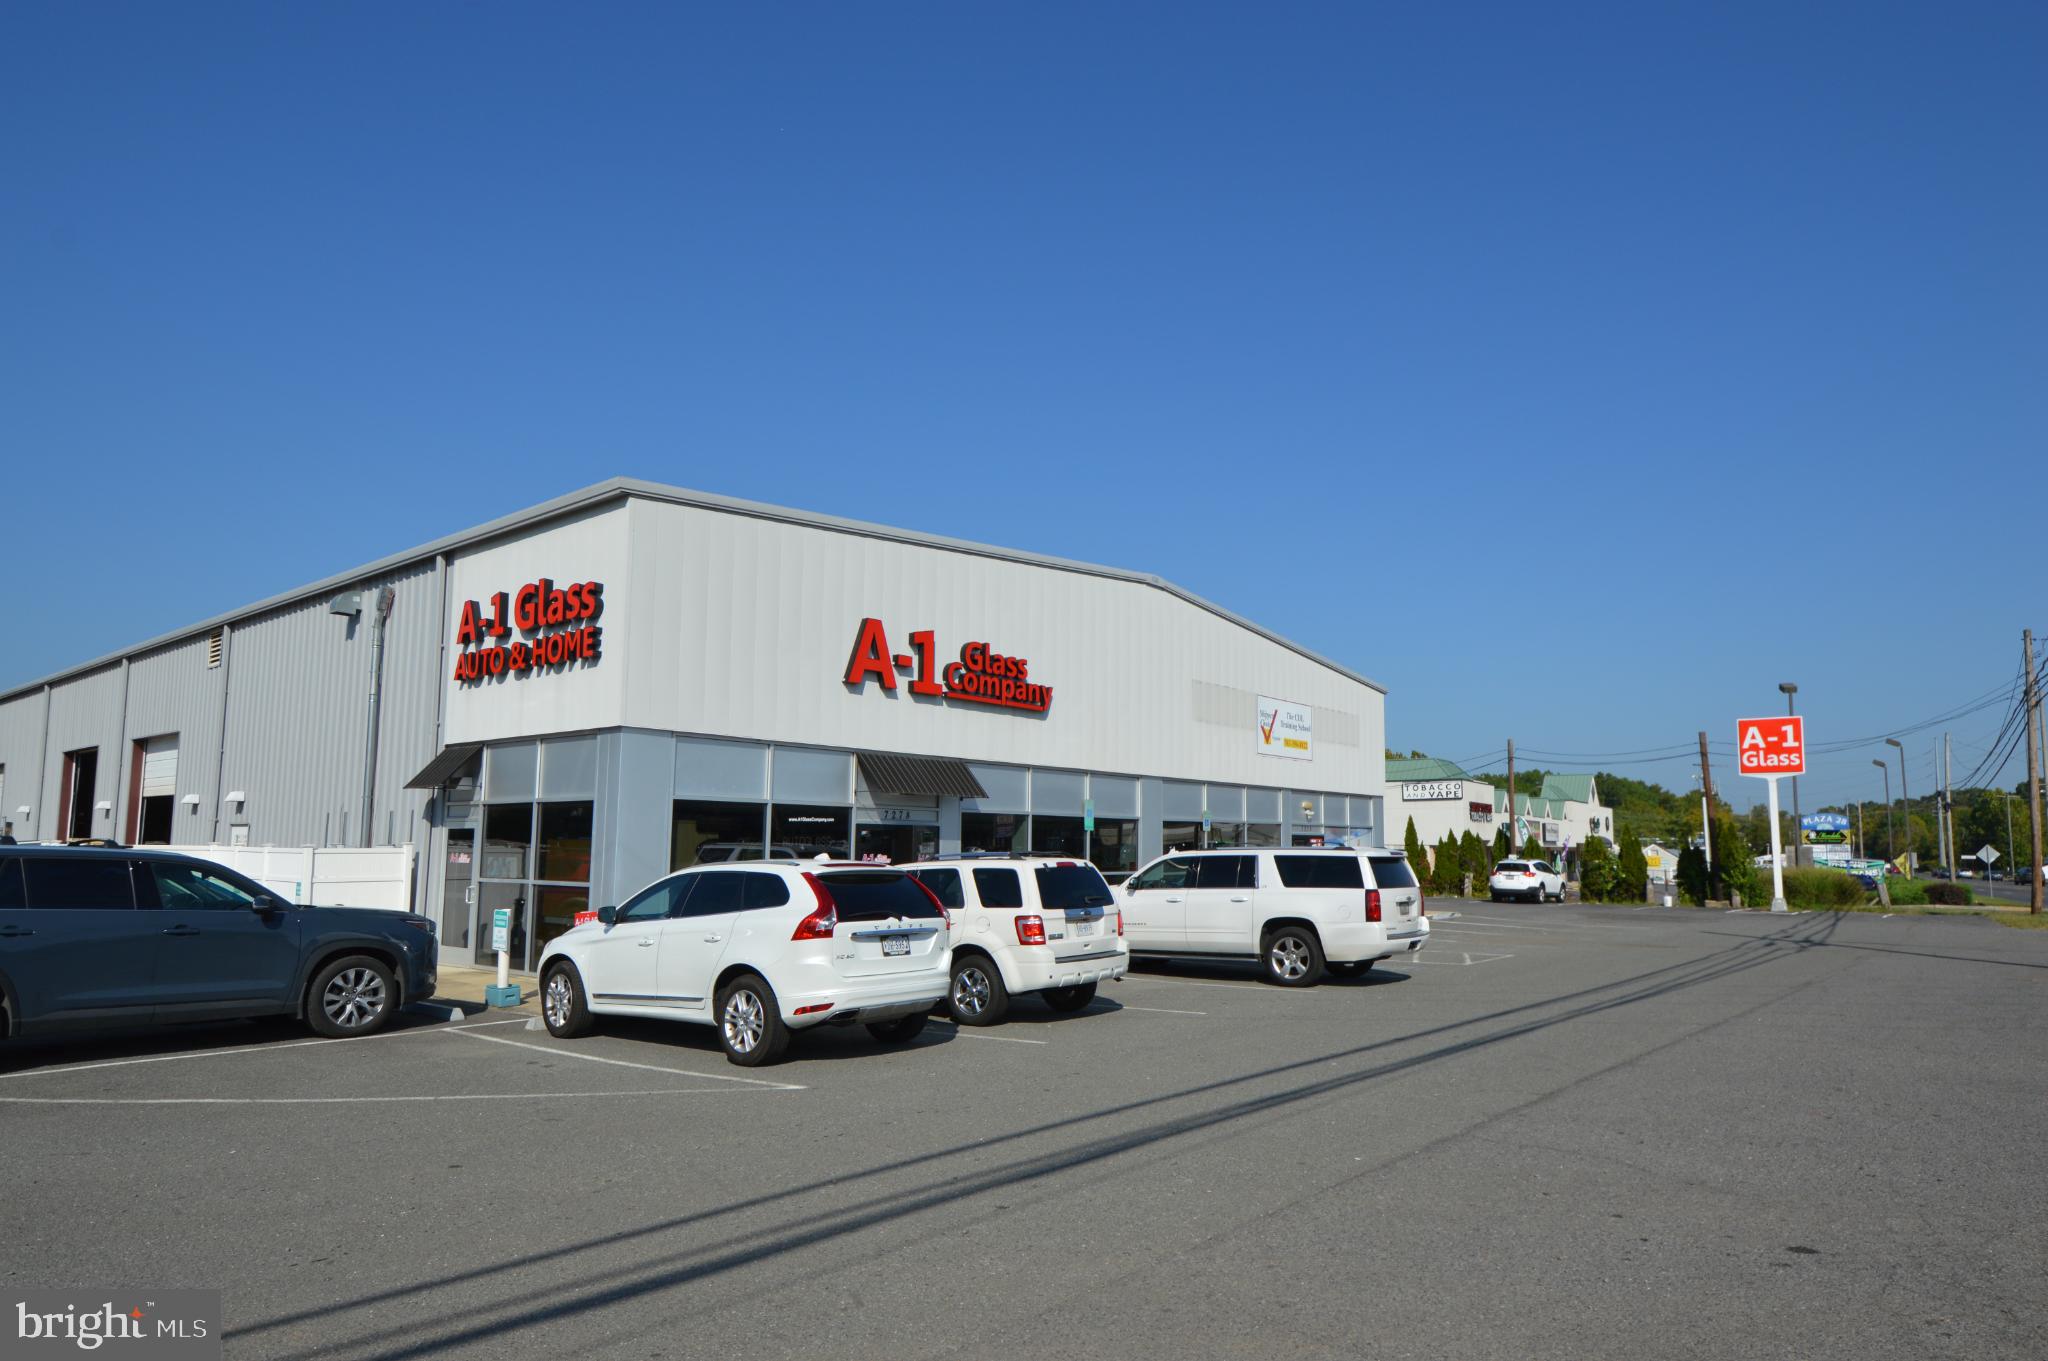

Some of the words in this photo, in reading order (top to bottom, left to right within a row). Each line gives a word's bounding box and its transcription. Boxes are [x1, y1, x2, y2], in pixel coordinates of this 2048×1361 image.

[456, 591, 509, 645] A-1
[514, 578, 601, 631] Glass
[454, 646, 506, 681] AUTO
[509, 642, 527, 671] &
[532, 626, 600, 667] HOME
[844, 618, 942, 697] A-1
[961, 641, 1028, 680] Glass
[943, 662, 1053, 711] Company
[1742, 725, 1800, 749] A-1
[1742, 750, 1800, 767] Glass
[1405, 783, 1461, 791] TOBACCO
[1803, 815, 1832, 825] PLAZA
